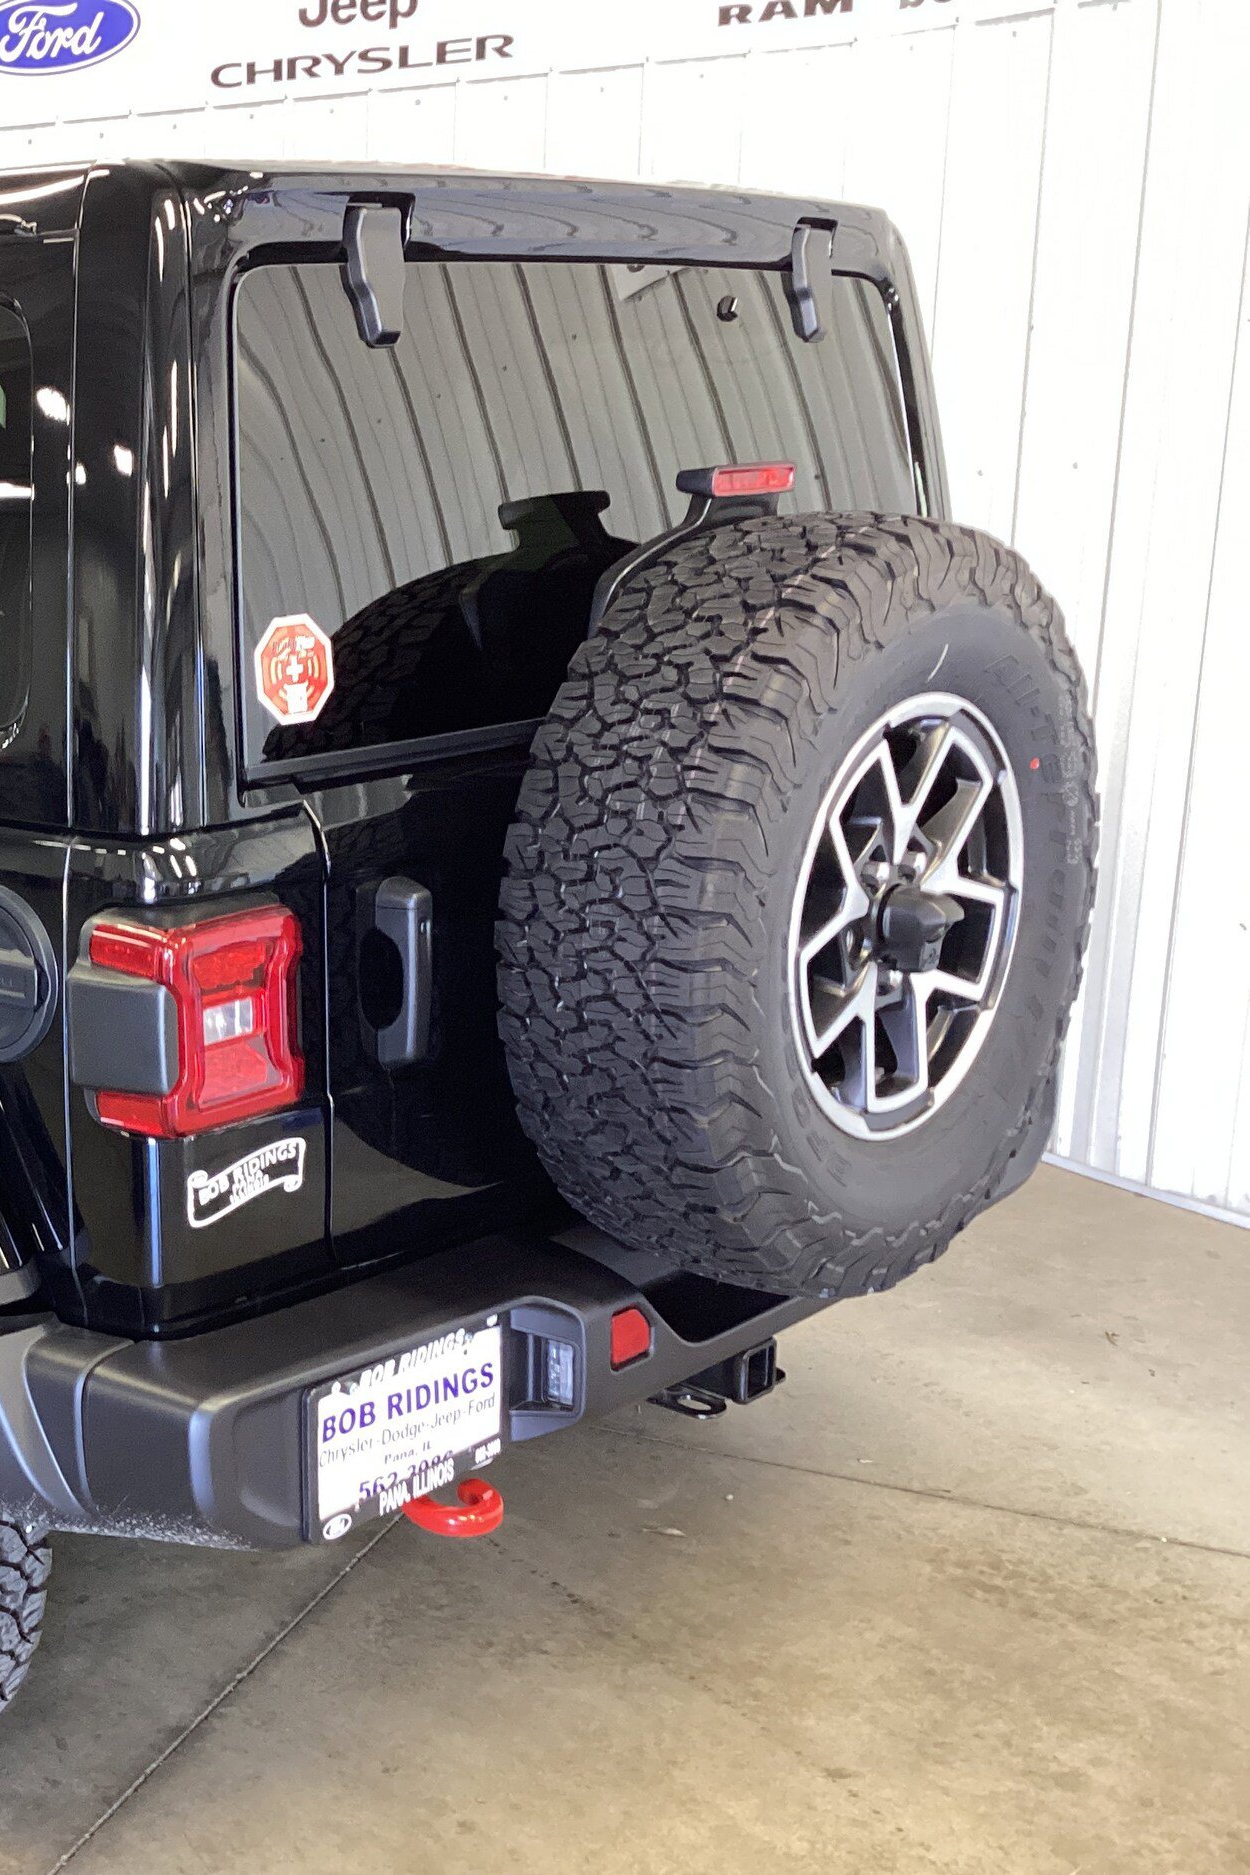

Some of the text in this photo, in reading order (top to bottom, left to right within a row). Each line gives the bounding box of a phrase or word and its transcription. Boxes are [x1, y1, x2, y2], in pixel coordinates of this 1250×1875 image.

[298, 0, 418, 29] Jeep
[717, 0, 854, 27] RAM
[210, 33, 515, 89] CHRYSLER
[233, 1142, 297, 1187] RIDINGS
[322, 1362, 494, 1444] BOB RIDINGS
[412, 1457, 455, 1500] ILLINOIS
